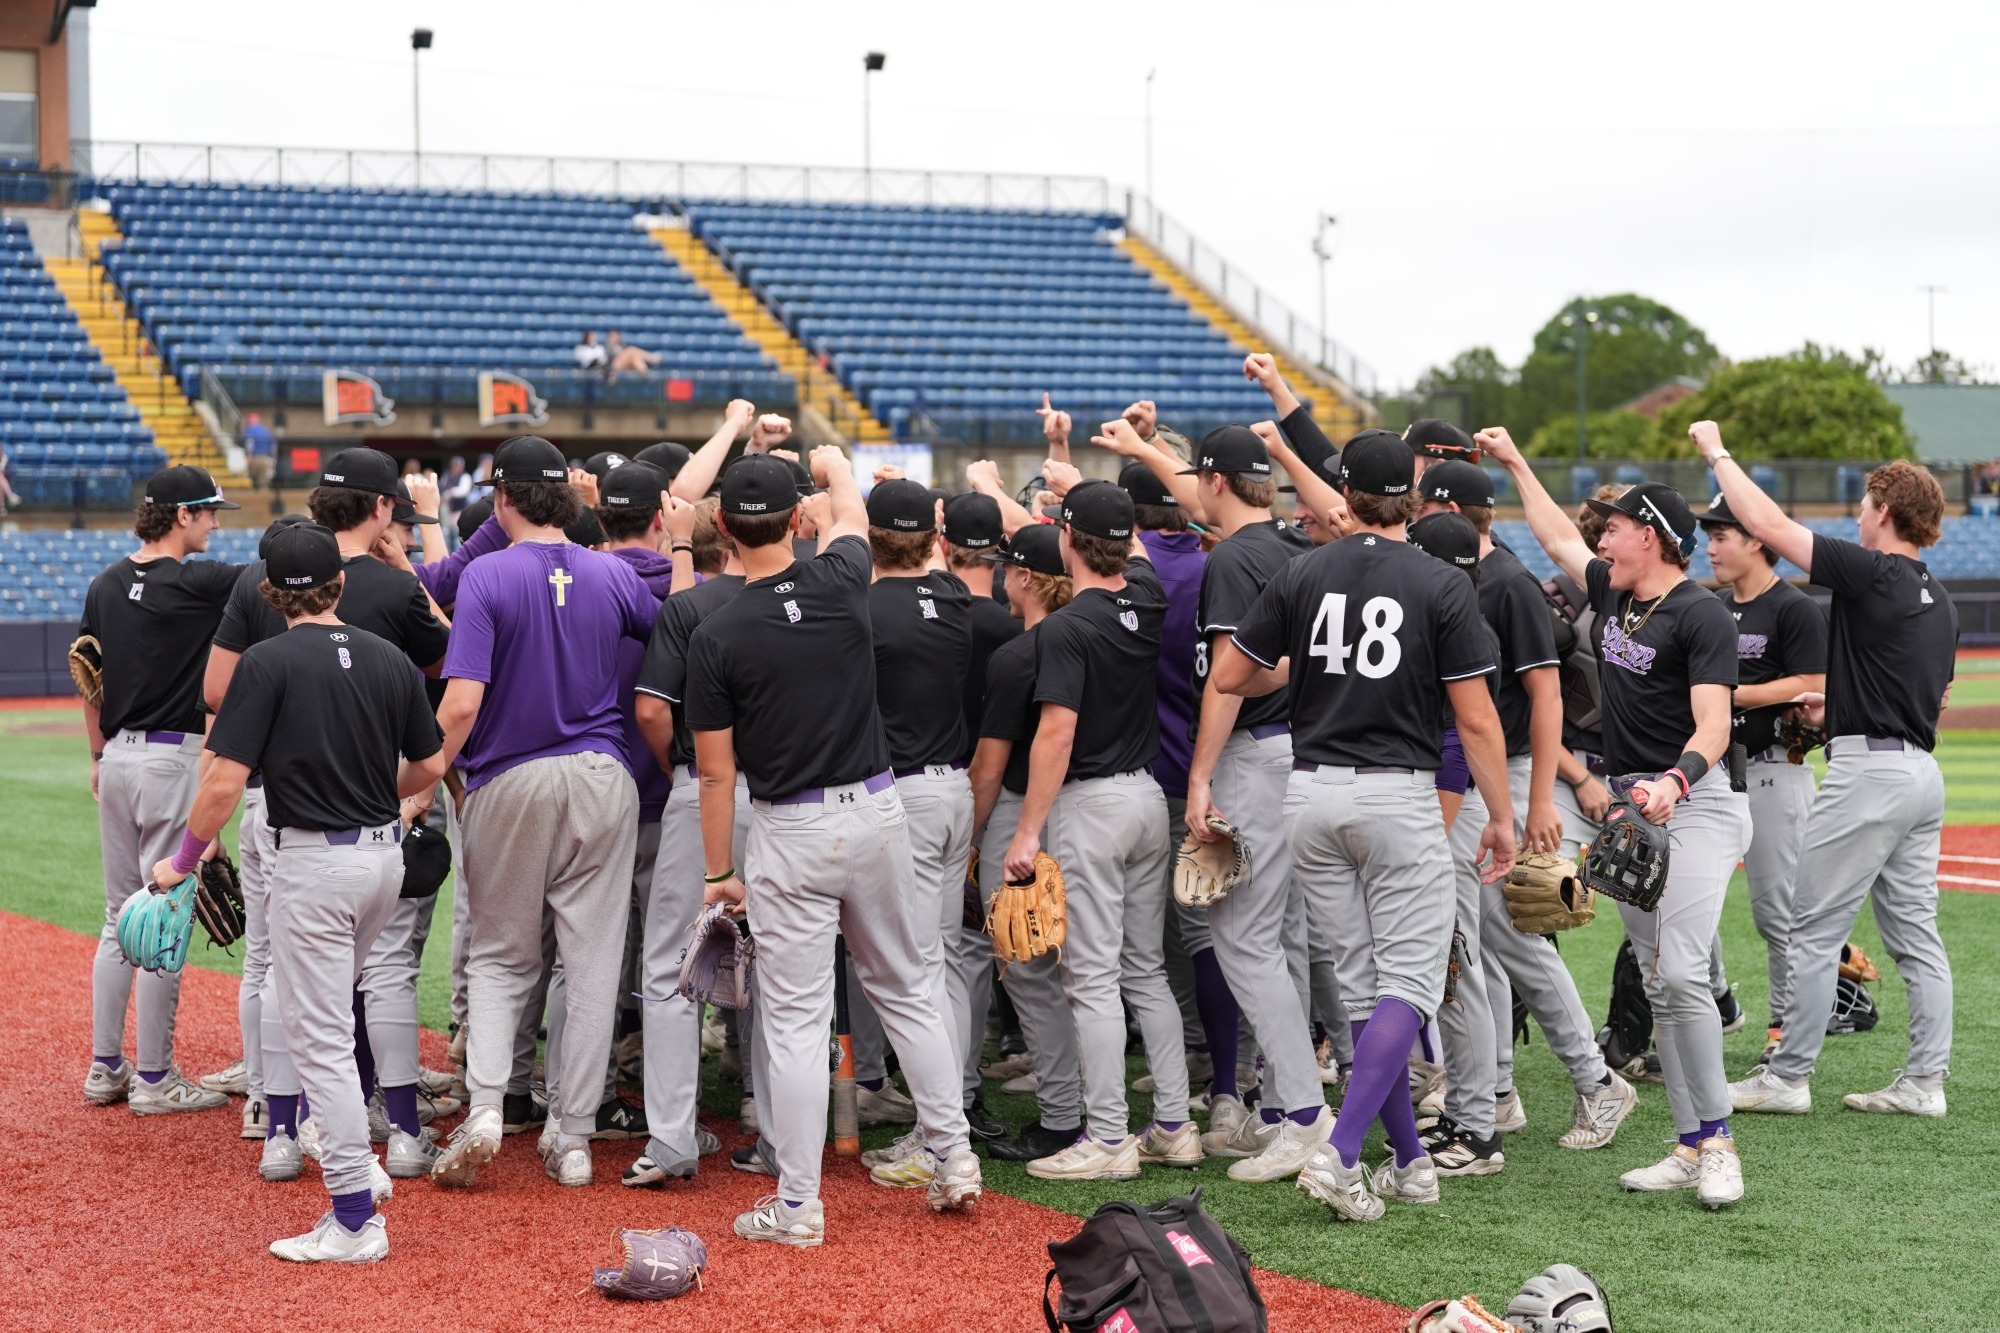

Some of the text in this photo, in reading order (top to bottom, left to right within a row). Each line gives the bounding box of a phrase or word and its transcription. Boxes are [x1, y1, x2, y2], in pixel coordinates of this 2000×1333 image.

[1252, 462, 1270, 471] TIGERS
[542, 469, 564, 477] TIGERS
[324, 473, 345, 483] TIGERS
[1384, 484, 1408, 493] TIGERS
[607, 496, 630, 504] TIGERS
[740, 502, 767, 511] TIGERS
[893, 518, 918, 527] TIGERS
[1109, 528, 1130, 537] TIGERS
[966, 538, 990, 546] TIGERS
[1454, 556, 1476, 565] TIGERS
[285, 576, 312, 585] TIGERS
[783, 600, 802, 624] 5
[918, 599, 939, 619] 31
[1308, 592, 1404, 679] 48
[338, 647, 351, 669] 8
[1643, 850, 1662, 890] Rawlings
